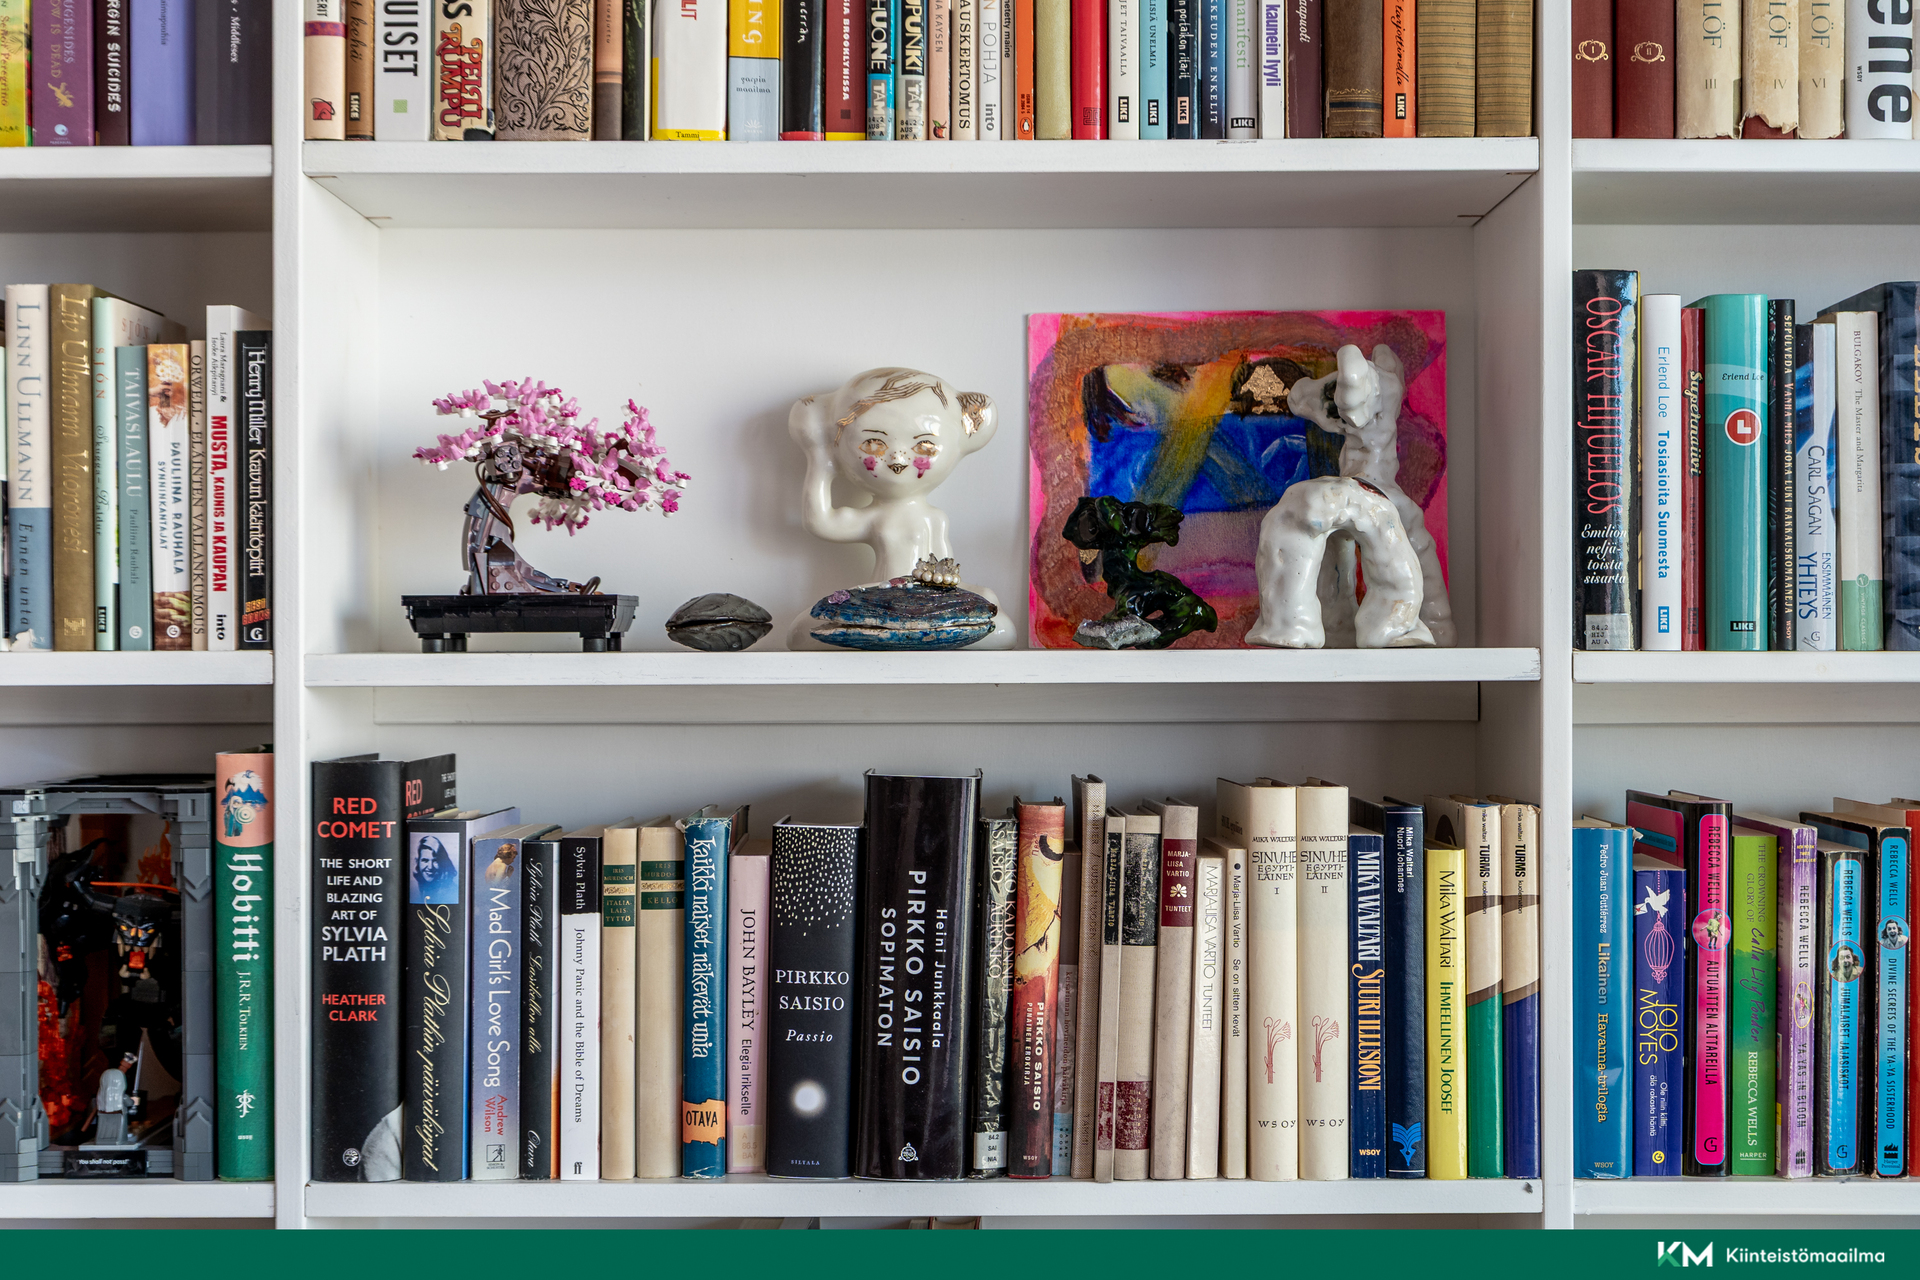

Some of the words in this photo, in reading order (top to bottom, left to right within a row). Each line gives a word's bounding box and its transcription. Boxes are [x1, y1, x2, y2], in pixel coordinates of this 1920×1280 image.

[230, 16, 241, 64] Middlesex
[350, 14, 368, 63] kehä
[935, 11, 943, 53] KAYSEN
[1175, 9, 1194, 49] portaikon
[1265, 4, 1281, 56] kaunein
[51, 44, 61, 79] DEAD
[842, 19, 850, 100] BROOKLYNISSA
[982, 22, 997, 84] POHJA
[1178, 53, 1190, 79] ritarit
[107, 42, 122, 113] SUICIDES
[1263, 59, 1281, 87] lyyli
[1704, 78, 1717, 90] III
[1773, 78, 1786, 90] IV
[1812, 78, 1826, 88] VI
[351, 94, 360, 121] LIKE
[1120, 98, 1128, 121] LIKE
[1149, 101, 1157, 124] LIKE
[1180, 99, 1188, 122] LIKE
[1210, 66, 1218, 124] ENKELIT
[984, 103, 995, 131] into
[1233, 119, 1253, 127] LIKE
[60, 294, 88, 333] Liv
[17, 302, 41, 368] LINN
[1586, 296, 1622, 383] OSCAR
[1784, 315, 1792, 374] SEPÚLVEDA
[1657, 347, 1671, 390] Erlend
[1722, 372, 1749, 381] Erlend
[1854, 330, 1863, 384] BULGAKOV
[61, 339, 90, 439] Ullmann
[191, 354, 202, 417] ORWELL
[1784, 383, 1794, 417] VANHA
[1657, 393, 1668, 418] Loe
[1855, 407, 1863, 433] Master
[17, 375, 41, 501] ULLMANN
[124, 367, 143, 498] TAIVASLAULU
[209, 416, 228, 475] MUSTA,
[1784, 421, 1792, 444] MIES
[170, 442, 183, 505] PAULIINA
[191, 431, 205, 511] ELÄINTEN
[1577, 393, 1623, 515] HIJUELOS
[1657, 430, 1670, 506] Tosiasioita
[1784, 448, 1792, 476] JOKA
[1808, 445, 1826, 482] CARL
[62, 449, 89, 554] Vuorovesi
[213, 477, 226, 518] KAUNIS
[1784, 480, 1792, 501] LUKI
[213, 520, 225, 533] JA
[1808, 486, 1826, 536] SAGAN
[18, 523, 34, 576] Ennen
[172, 512, 184, 575] RAUHALA
[1581, 524, 1627, 540] Emilion
[1586, 541, 1621, 560] neljä-
[1657, 511, 1670, 579] Suomesta
[193, 512, 205, 635] VALLANKUMOUS
[212, 535, 227, 593] KAUPAN
[1583, 571, 1627, 585] sisarta
[1587, 557, 1622, 571] toista
[1784, 505, 1793, 614] RAKKAUSROMAANEJA
[1798, 551, 1818, 620] YHTEYS
[1820, 552, 1832, 620] ENSIMMÄINEN
[18, 587, 32, 626] unta
[1660, 609, 1668, 630] LIKE
[1733, 622, 1754, 630] LIKE
[215, 613, 227, 640] into
[333, 798, 377, 814] RED
[317, 821, 396, 838] COMET
[1708, 825, 1720, 868] REBECCA
[320, 858, 342, 868] THE
[348, 858, 392, 869] SHORT
[573, 846, 586, 878] Sylvia
[1252, 851, 1296, 864] SINUHE
[1300, 851, 1347, 863] SINUHE
[1357, 851, 1380, 892] MIKA
[1479, 844, 1490, 878] TURMS
[1515, 844, 1526, 878] TURMS
[1889, 844, 1898, 879] REBECCA
[326, 893, 383, 903] BLAZING
[327, 876, 350, 885] LIFE
[353, 876, 382, 885] AND
[575, 880, 586, 910] Plath
[1231, 875, 1241, 921] Marja-Liisa
[1708, 871, 1720, 904] WELLS
[1758, 866, 1766, 923] CROWNING
[1843, 869, 1853, 906] REBECCA
[1889, 881, 1898, 907] WELLS
[227, 853, 263, 962] Hobitti
[331, 910, 355, 920] ART
[359, 910, 377, 920] OF
[489, 887, 512, 934] Mad
[905, 870, 927, 976] PIRKKO
[1800, 885, 1809, 931] REBECCA
[1842, 908, 1852, 937] WELLS
[322, 927, 388, 941] SYLVIA
[573, 928, 586, 965] Johnny
[741, 909, 756, 960] JOHN
[935, 909, 948, 953] Heini
[988, 900, 1003, 979] AURINKO
[1233, 923, 1241, 948] Vartio
[1357, 896, 1381, 961] WALTARI
[322, 946, 386, 962] PLATH
[1799, 935, 1809, 968] WELLS
[575, 968, 585, 996] Panic
[775, 969, 850, 985] PIRKKO
[877, 908, 897, 1047] SOPIMATON
[1598, 942, 1611, 1005] Likainen
[1706, 960, 1719, 1019] AUTUAITTEN
[322, 994, 386, 1006] HEATHER
[329, 1010, 377, 1021] CLARK
[488, 991, 511, 1036] Love
[575, 999, 585, 1019] and
[742, 965, 756, 1031] BAYLEY
[779, 995, 845, 1011] SAISIO
[932, 961, 946, 1048] Junkkaala
[1232, 987, 1240, 1011] sitten
[1839, 988, 1850, 1038] JUMALAISET
[1888, 988, 1897, 1021] SECRETS
[575, 1022, 585, 1039] the
[785, 1029, 834, 1043] Passio
[902, 989, 923, 1085] SAISIO
[1034, 1002, 1045, 1056] PIRKKO
[1440, 981, 1454, 1064] IHMEELLINEN
[1639, 988, 1658, 1065] MOYES
[1655, 1000, 1679, 1052] JOJO
[483, 1040, 510, 1088] Song
[575, 1041, 585, 1067] Bible
[739, 1038, 752, 1072] Elegia
[1358, 1019, 1381, 1091] ILLUSIONI
[1596, 1013, 1609, 1123] Havanna-trilogia
[1705, 1023, 1718, 1085] ALTTAREILLA
[741, 1073, 751, 1116] Irikselle
[1033, 1062, 1043, 1112] SAISIO
[1440, 1067, 1454, 1115] JOOSEF
[1747, 1051, 1758, 1104] REBECCA
[484, 1096, 496, 1133] Wilson
[497, 1094, 508, 1136] Andrew
[575, 1084, 585, 1123] Dreams
[686, 1110, 718, 1127] OTAVA
[1797, 1095, 1806, 1128] BLOOM
[1886, 1080, 1896, 1129] SISTERHOOD
[1747, 1107, 1758, 1146] WELLS
